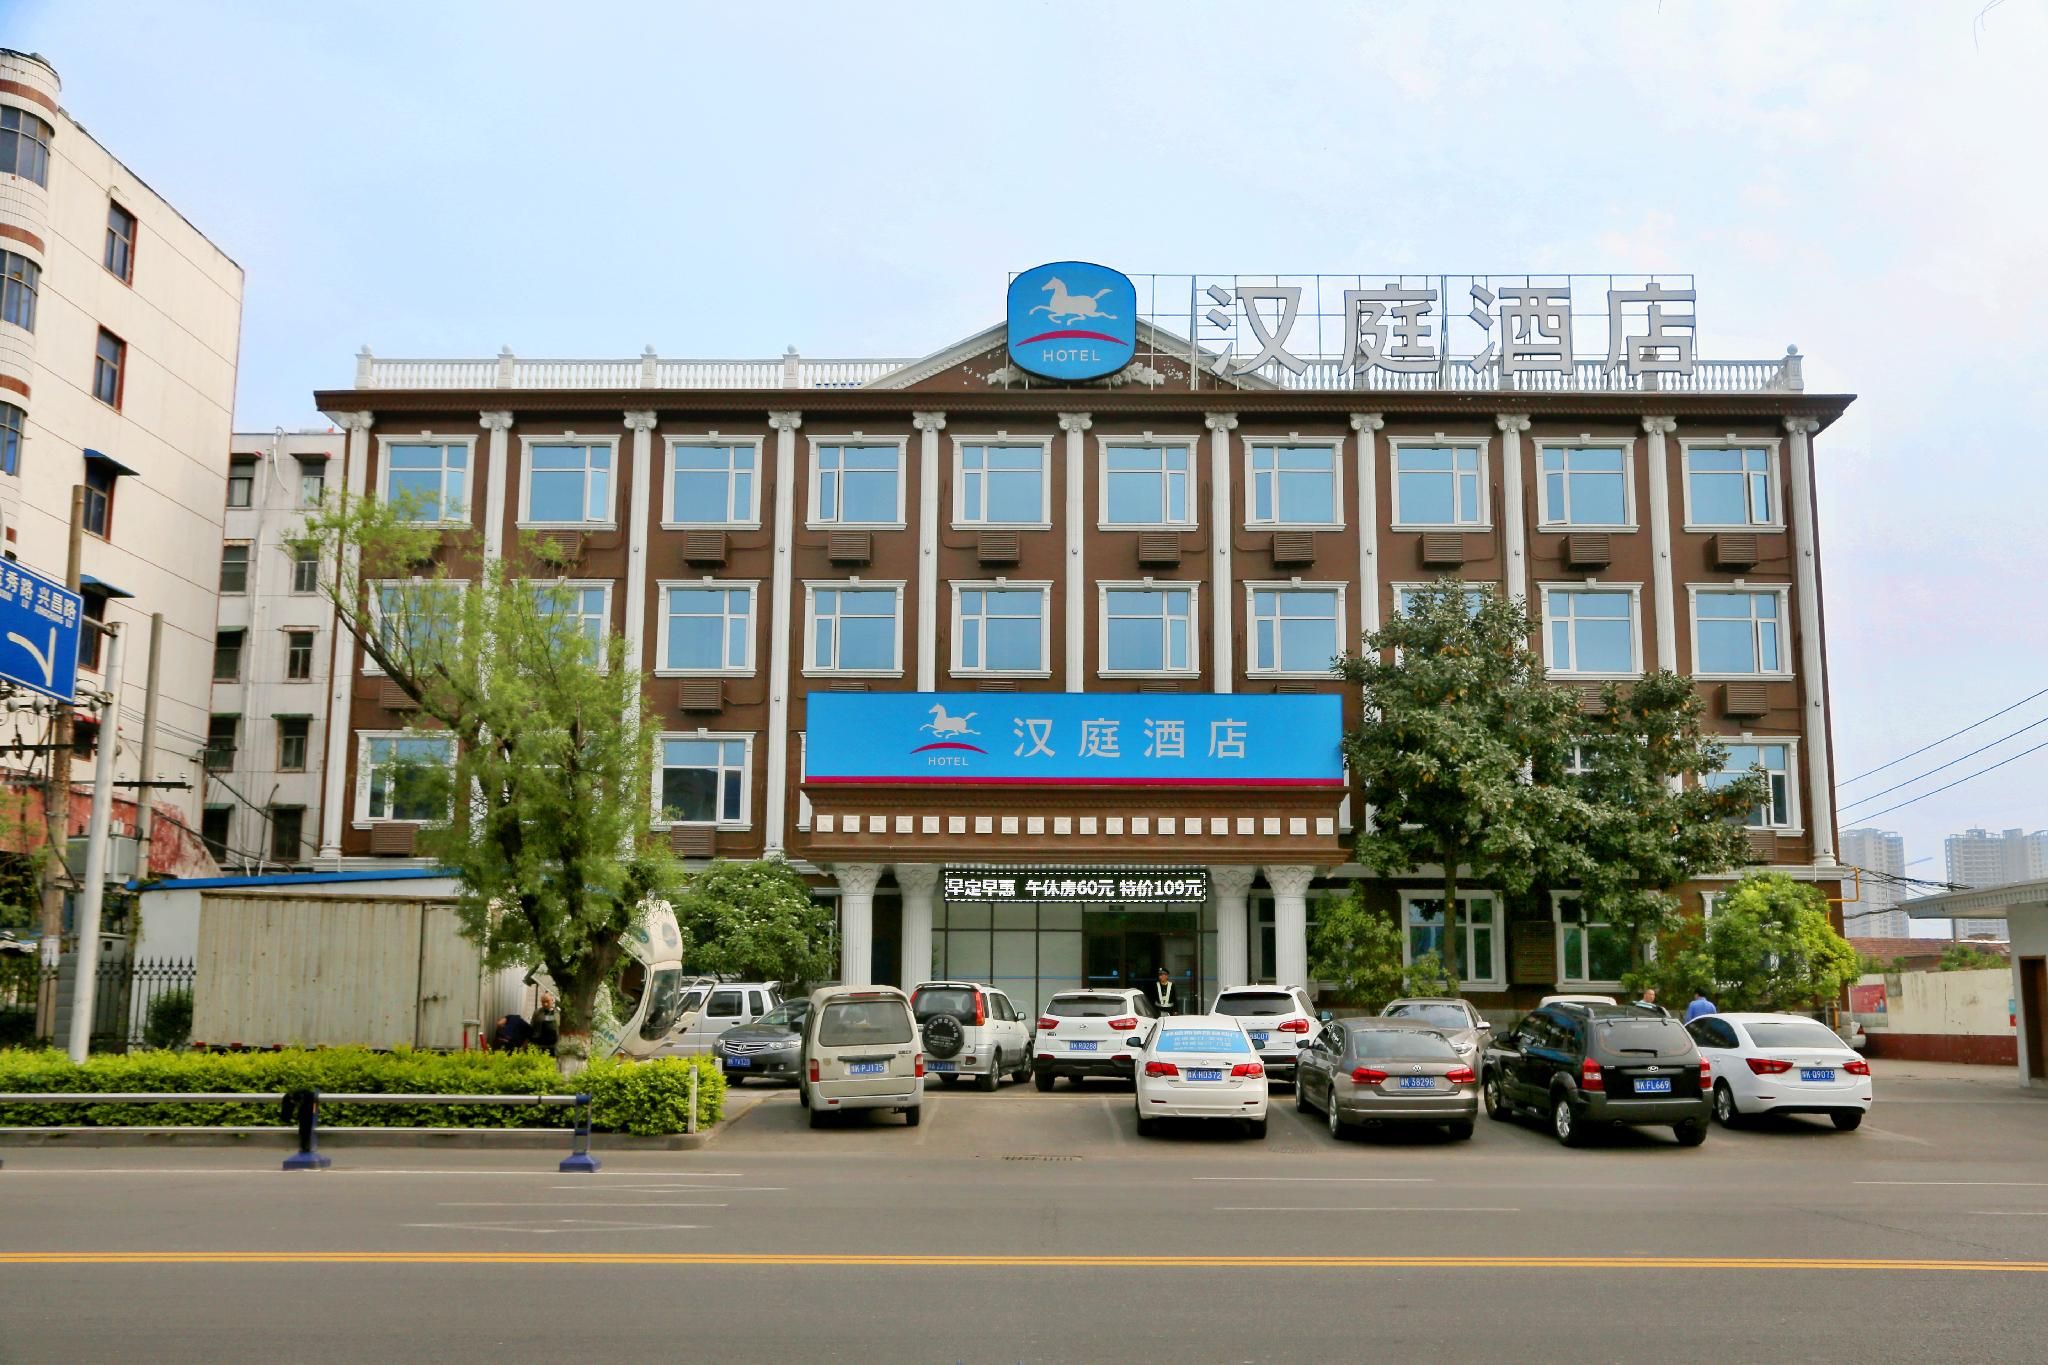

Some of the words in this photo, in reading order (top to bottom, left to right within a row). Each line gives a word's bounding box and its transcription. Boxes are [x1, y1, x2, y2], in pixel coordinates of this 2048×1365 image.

[1206, 283, 1696, 377] 汉庭酒店
[1043, 349, 1101, 362] HOTEL
[1013, 718, 1248, 759] 汉庭酒店
[928, 756, 969, 766] HOTEL
[947, 879, 1016, 897] 早定早惠
[1025, 879, 1115, 897] 午休房60元
[1120, 879, 1203, 897] 特价109元
